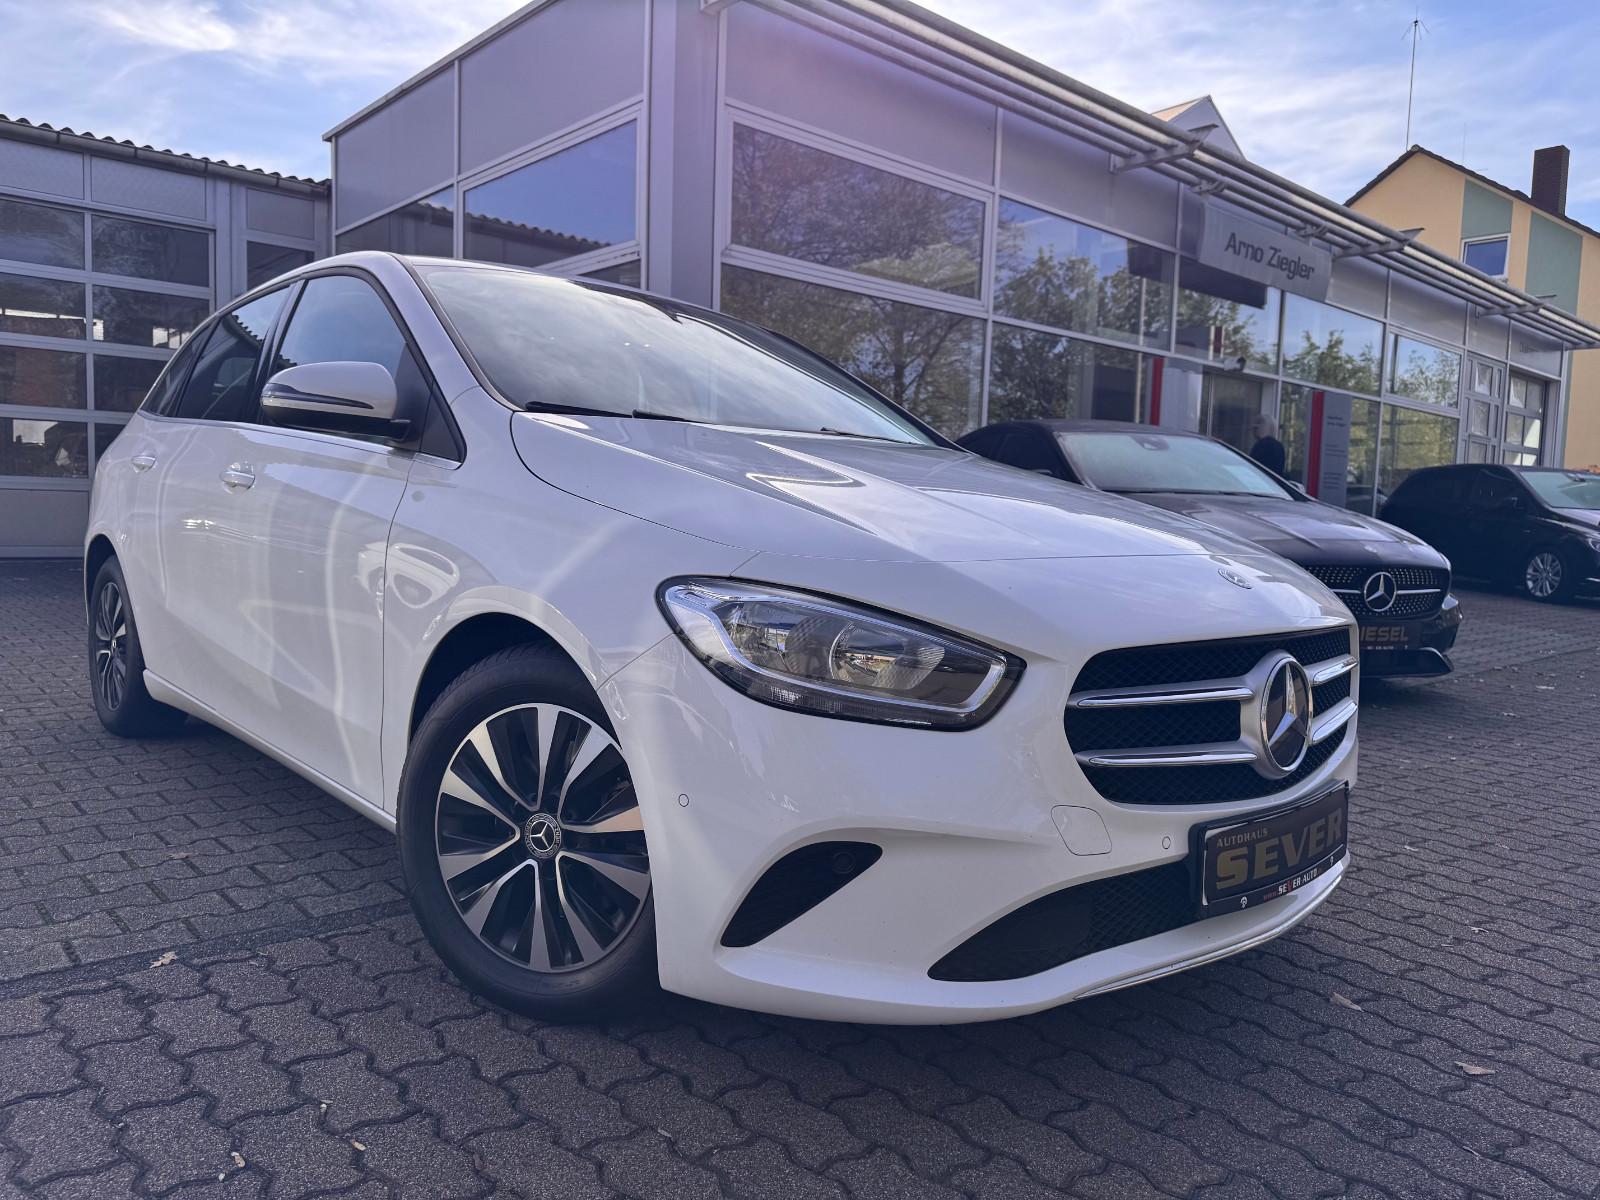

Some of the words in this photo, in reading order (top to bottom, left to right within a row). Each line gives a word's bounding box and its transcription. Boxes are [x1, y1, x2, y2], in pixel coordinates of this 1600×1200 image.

[1224, 232, 1264, 264] Arno
[1266, 246, 1315, 280] Ziegler
[1360, 626, 1409, 642] IESEL
[1216, 827, 1268, 849] AUTOHAUS
[1216, 807, 1343, 890] SEVER
